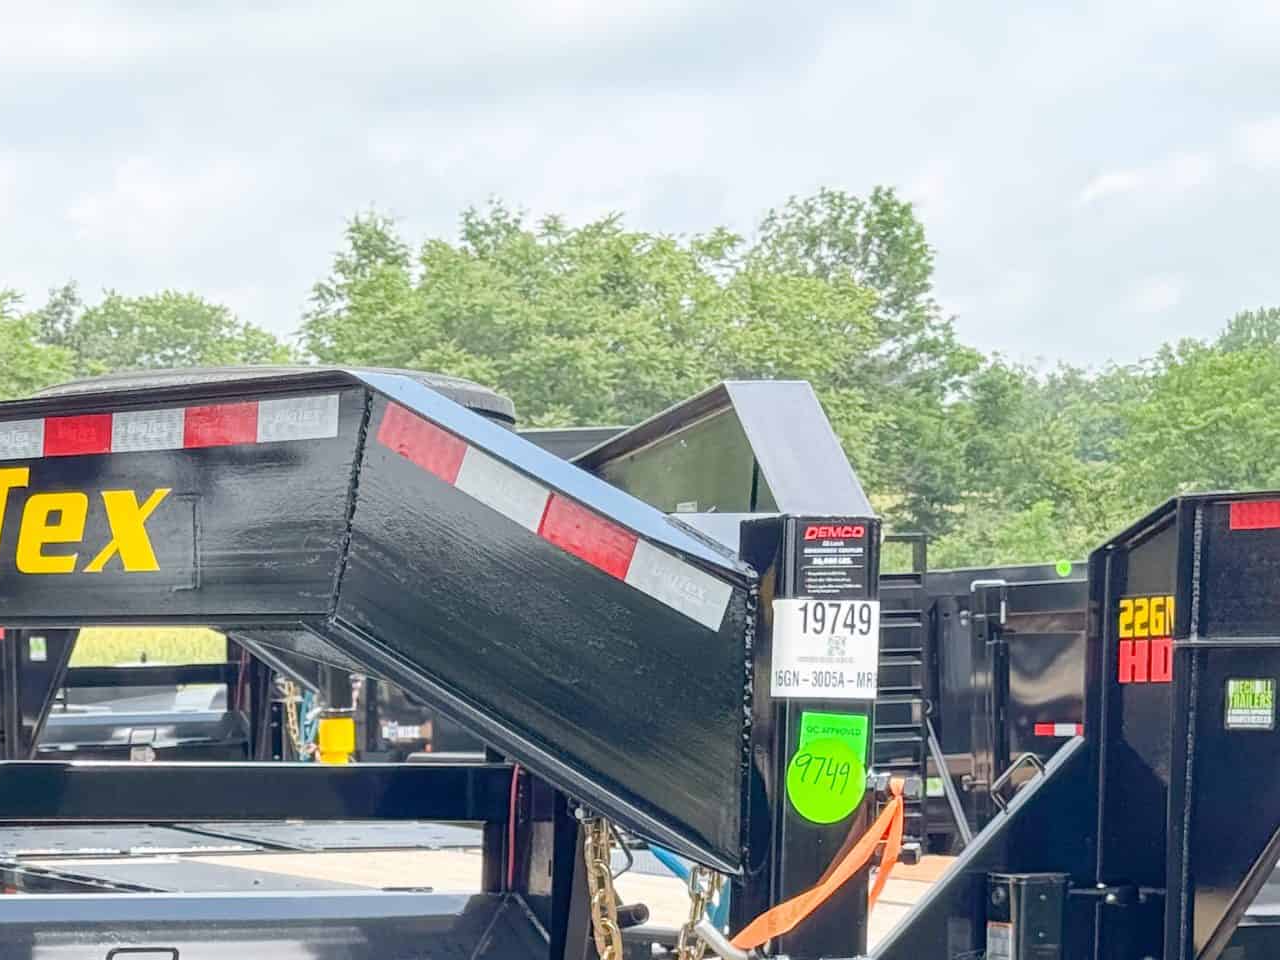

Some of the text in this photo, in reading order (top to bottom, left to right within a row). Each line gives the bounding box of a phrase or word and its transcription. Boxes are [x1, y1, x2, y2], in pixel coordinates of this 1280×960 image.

[804, 525, 865, 540] DEMCO
[798, 601, 872, 636] 19749
[1118, 638, 1174, 683] HD
[795, 753, 851, 796] 9749
